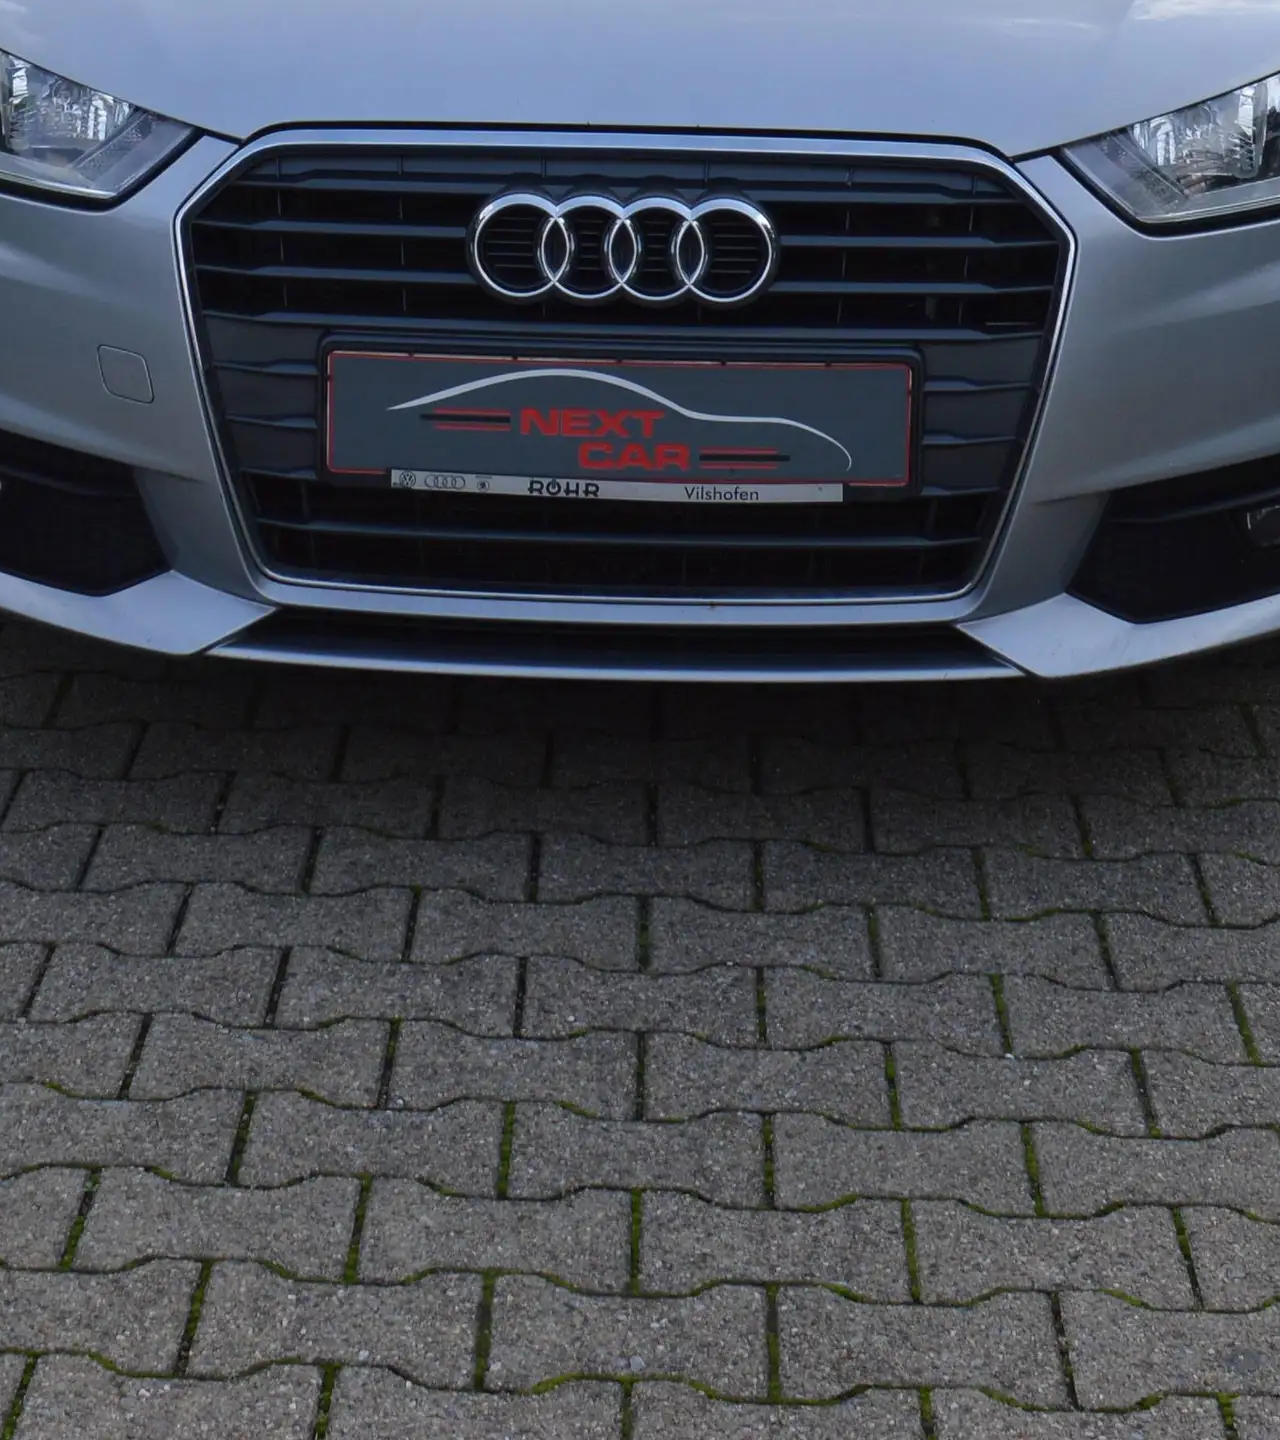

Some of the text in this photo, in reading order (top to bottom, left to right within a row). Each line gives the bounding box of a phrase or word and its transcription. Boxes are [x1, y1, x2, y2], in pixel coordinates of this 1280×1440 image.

[520, 407, 665, 437] NEXT
[577, 441, 691, 471] CAR
[527, 479, 600, 498] RÖHR
[684, 486, 760, 501] Vilshofen
